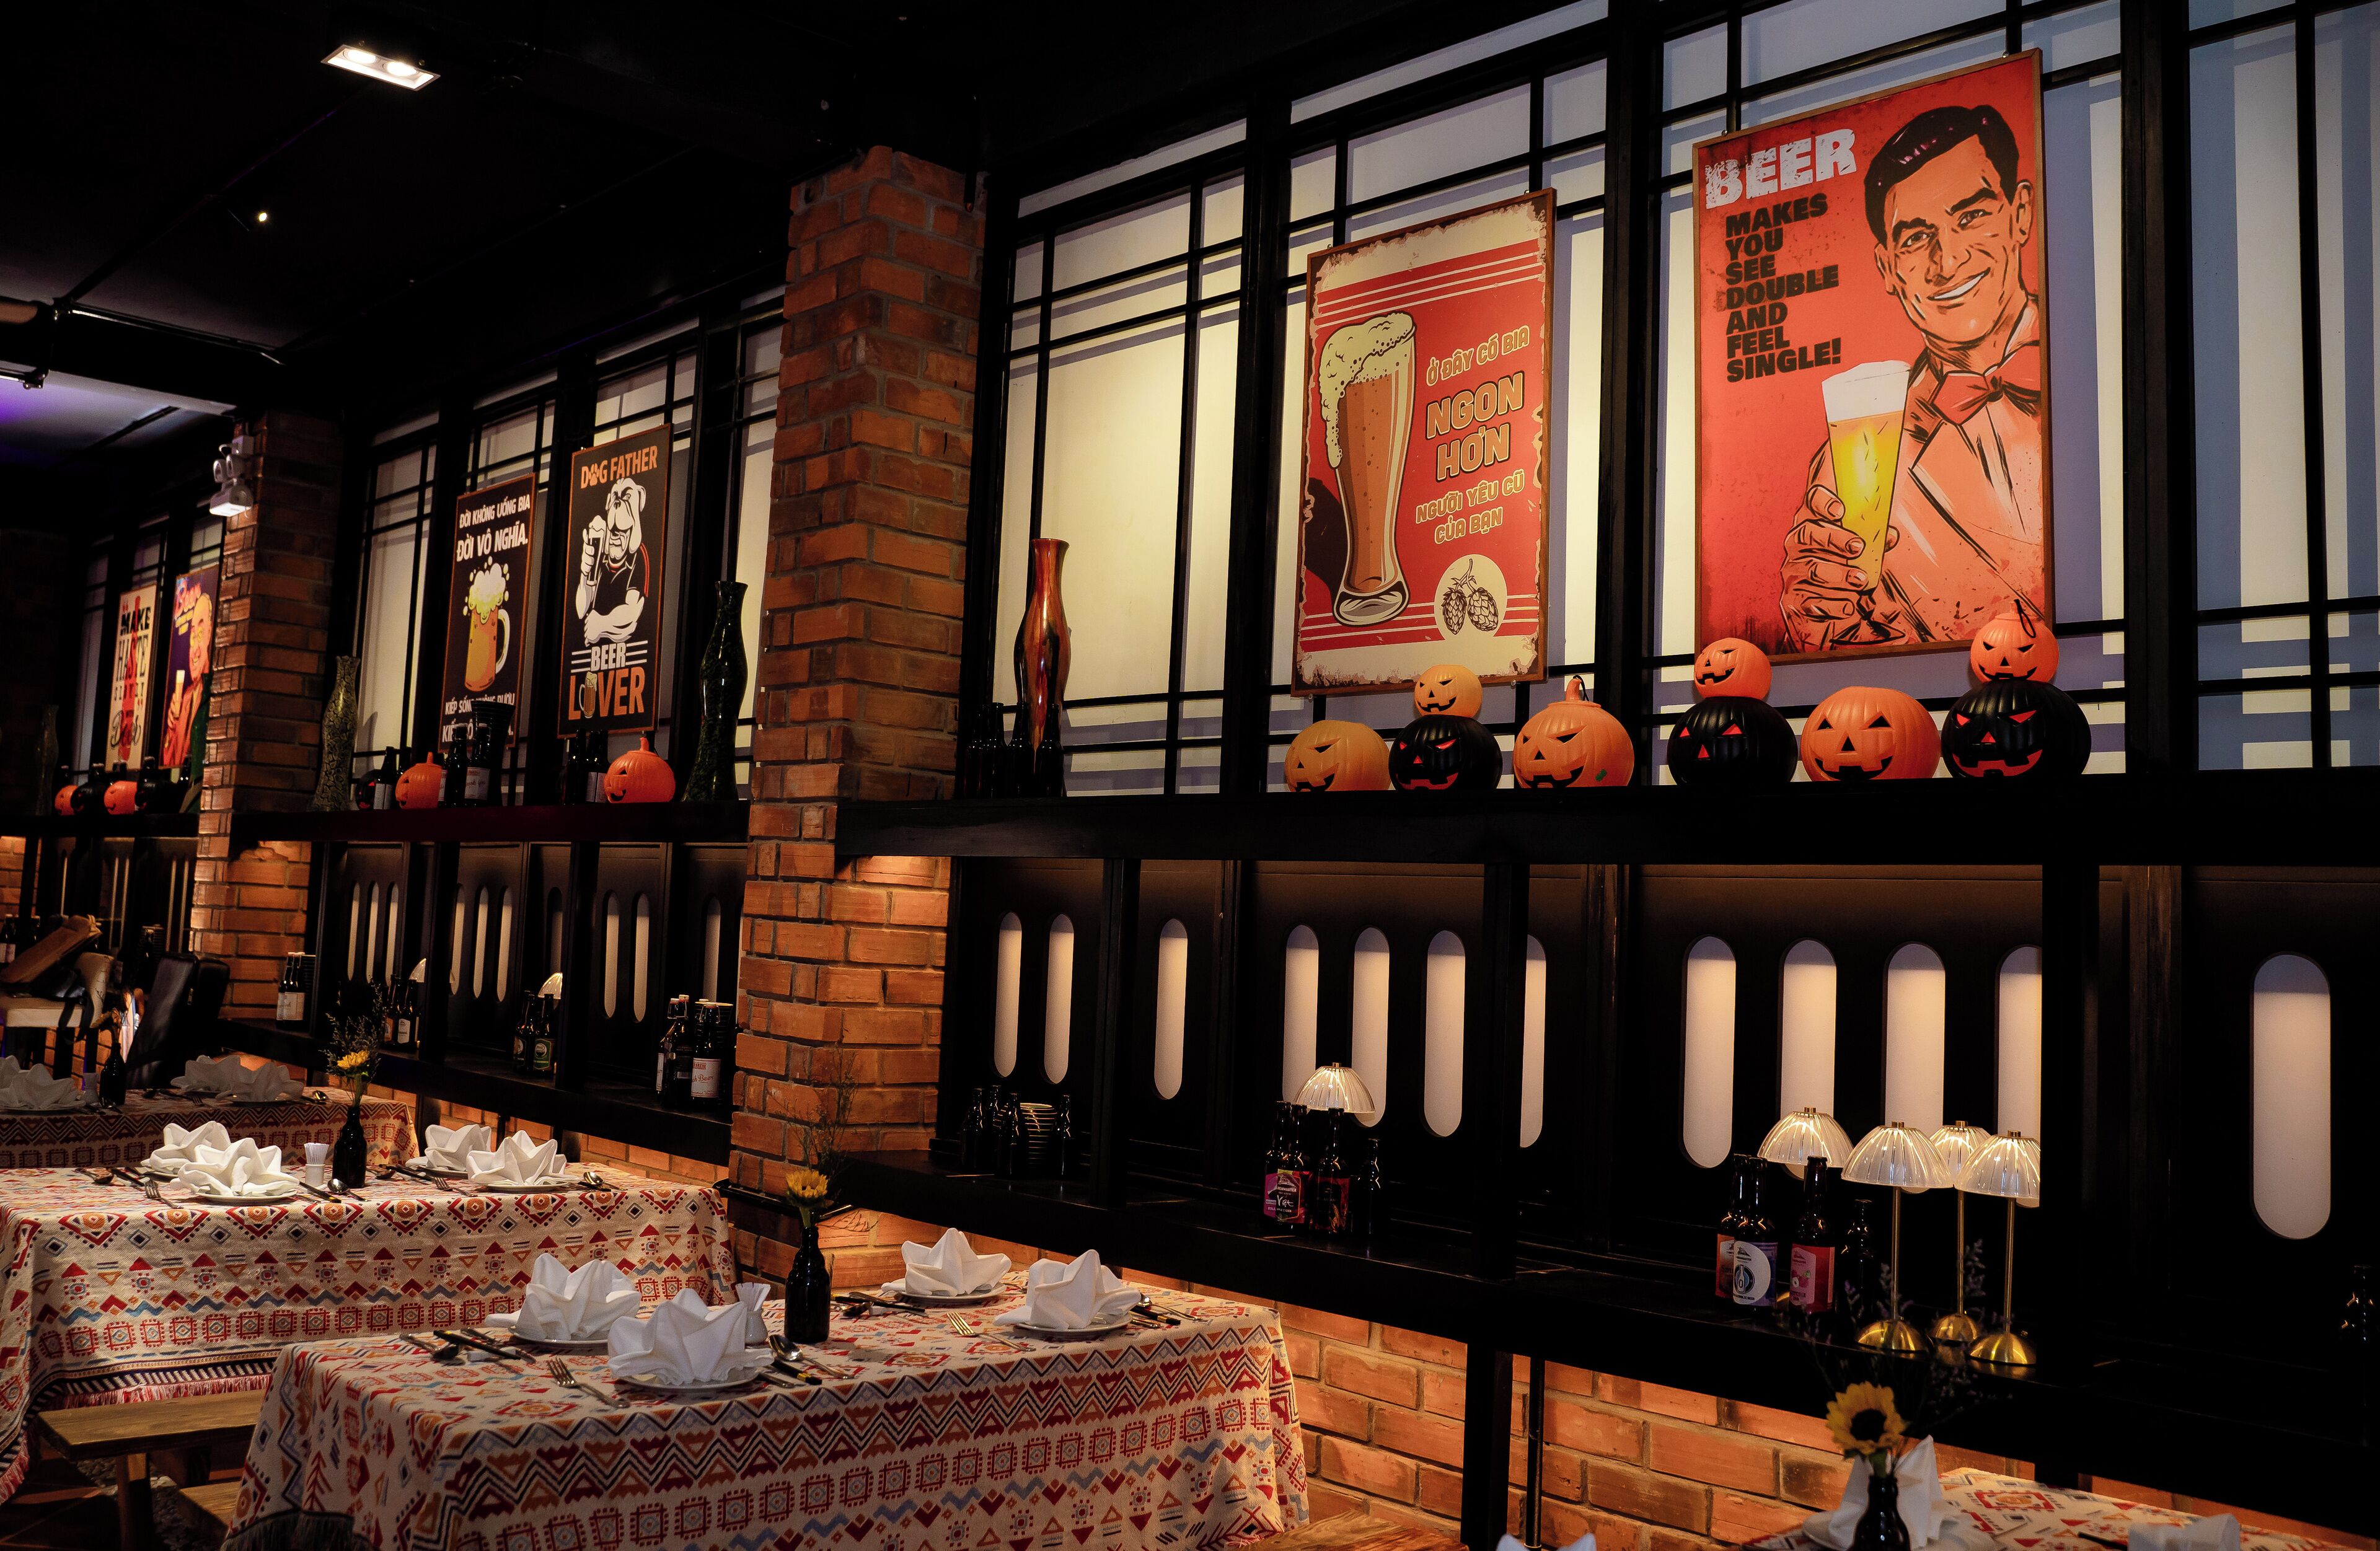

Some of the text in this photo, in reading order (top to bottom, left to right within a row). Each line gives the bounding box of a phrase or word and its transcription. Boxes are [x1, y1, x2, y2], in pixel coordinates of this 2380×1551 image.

[1705, 128, 1857, 209] BEER
[1726, 193, 1828, 239] MAKES
[1726, 227, 1784, 262] YOU
[1726, 255, 1776, 286] SEE
[1726, 265, 1839, 310] DOUBLE
[1726, 302, 1788, 335] AND
[1426, 325, 1530, 387] Ở ĐÂY CÓ BIA
[1726, 326, 1790, 360] FEEL
[1727, 338, 1841, 383] SINGLE!
[1427, 371, 1524, 440] NGON
[610, 446, 658, 481] FATHER
[1437, 423, 1510, 481] HƠN
[1466, 480, 1499, 507] YÊU
[1502, 468, 1525, 496] CŨ
[472, 504, 495, 525] KHÔNG
[496, 496, 517, 518] UỐNG
[518, 494, 531, 512] BIA
[1434, 506, 1504, 544] CỦA BẠN
[456, 521, 528, 562] ĐỜI VÔ NGHĨA.
[120, 607, 151, 636] MAKE
[591, 642, 626, 672] BEER
[445, 696, 458, 715] KIẾP
[459, 695, 474, 713] SỐN
